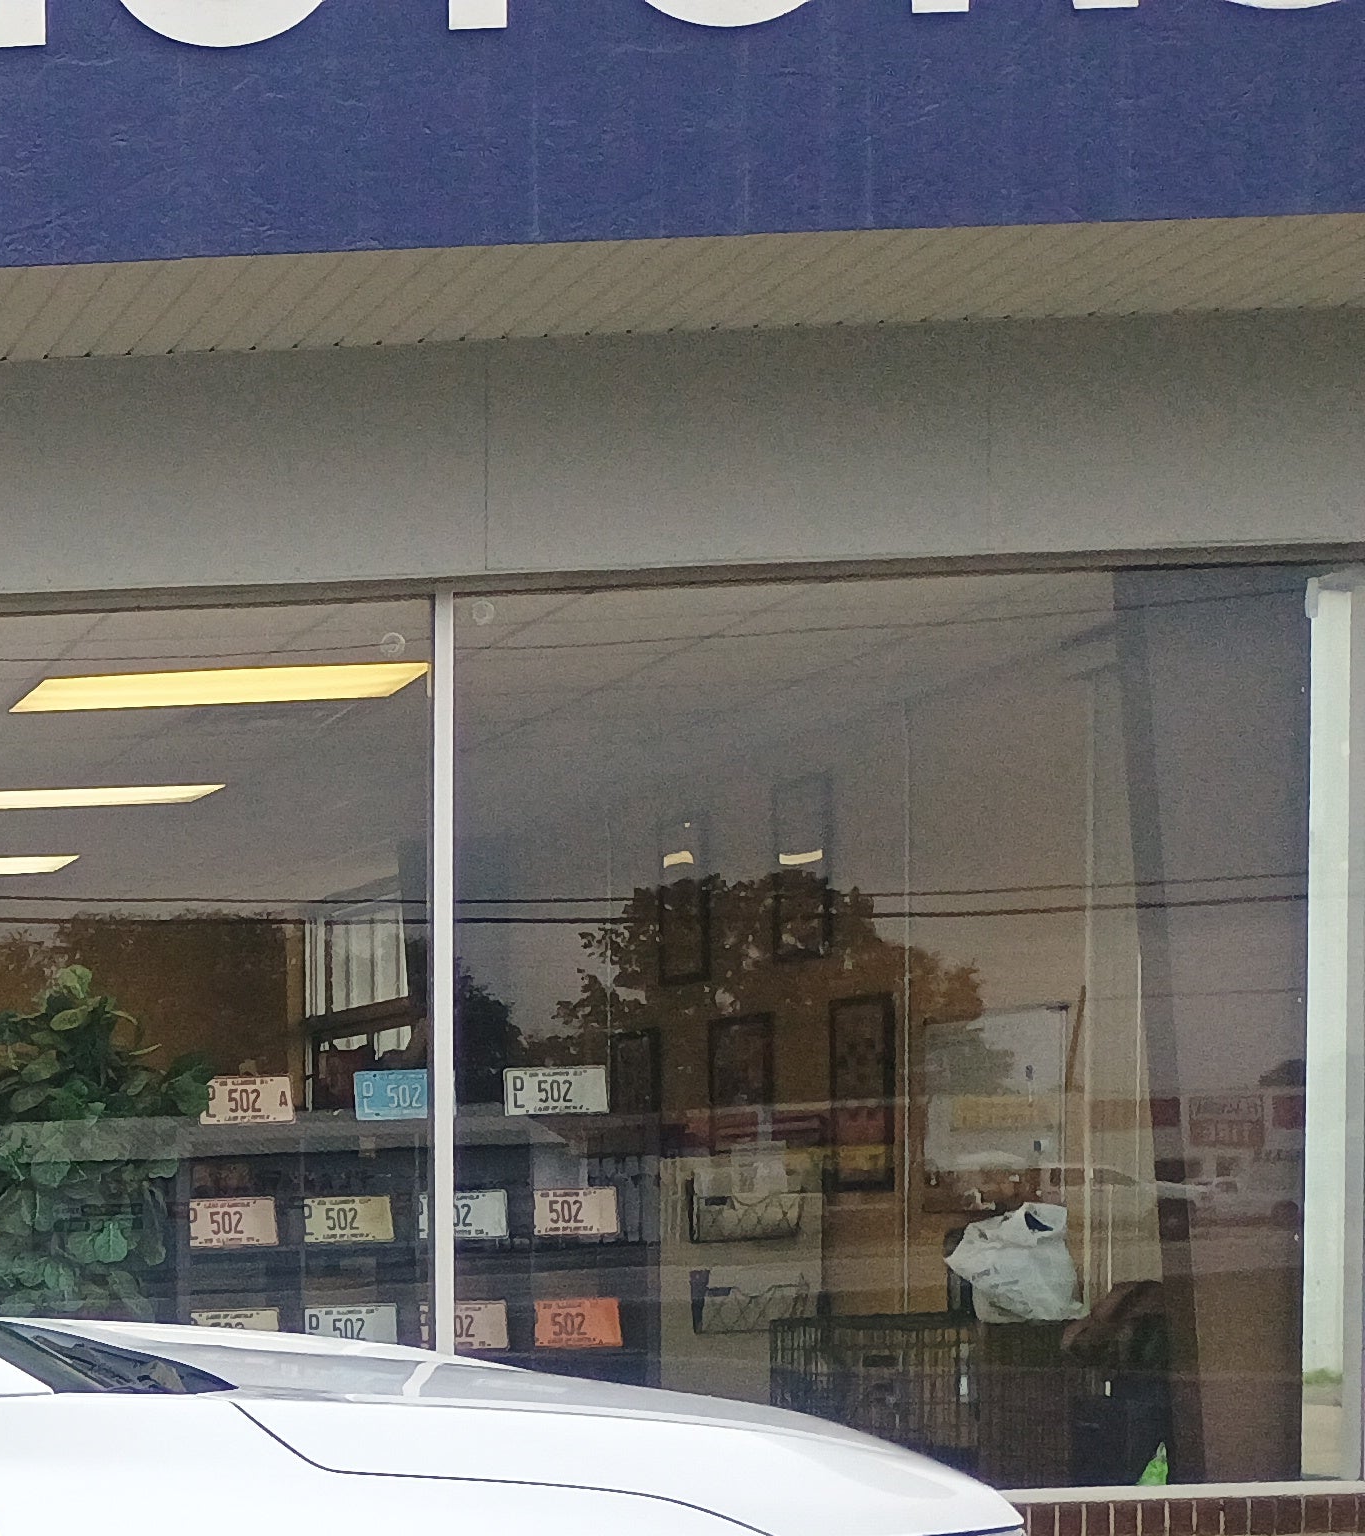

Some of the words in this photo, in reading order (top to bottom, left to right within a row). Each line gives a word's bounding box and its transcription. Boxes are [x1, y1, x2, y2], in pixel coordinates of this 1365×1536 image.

[227, 1088, 262, 1113] 502
[278, 1090, 289, 1108] A
[386, 1084, 423, 1108] 502
[537, 1079, 573, 1103] 502
[209, 1210, 245, 1236] 502
[325, 1207, 360, 1231] 502
[549, 1199, 585, 1225] 502
[332, 1317, 367, 1340] 502
[454, 1314, 476, 1338] 02
[550, 1311, 588, 1337] 502
